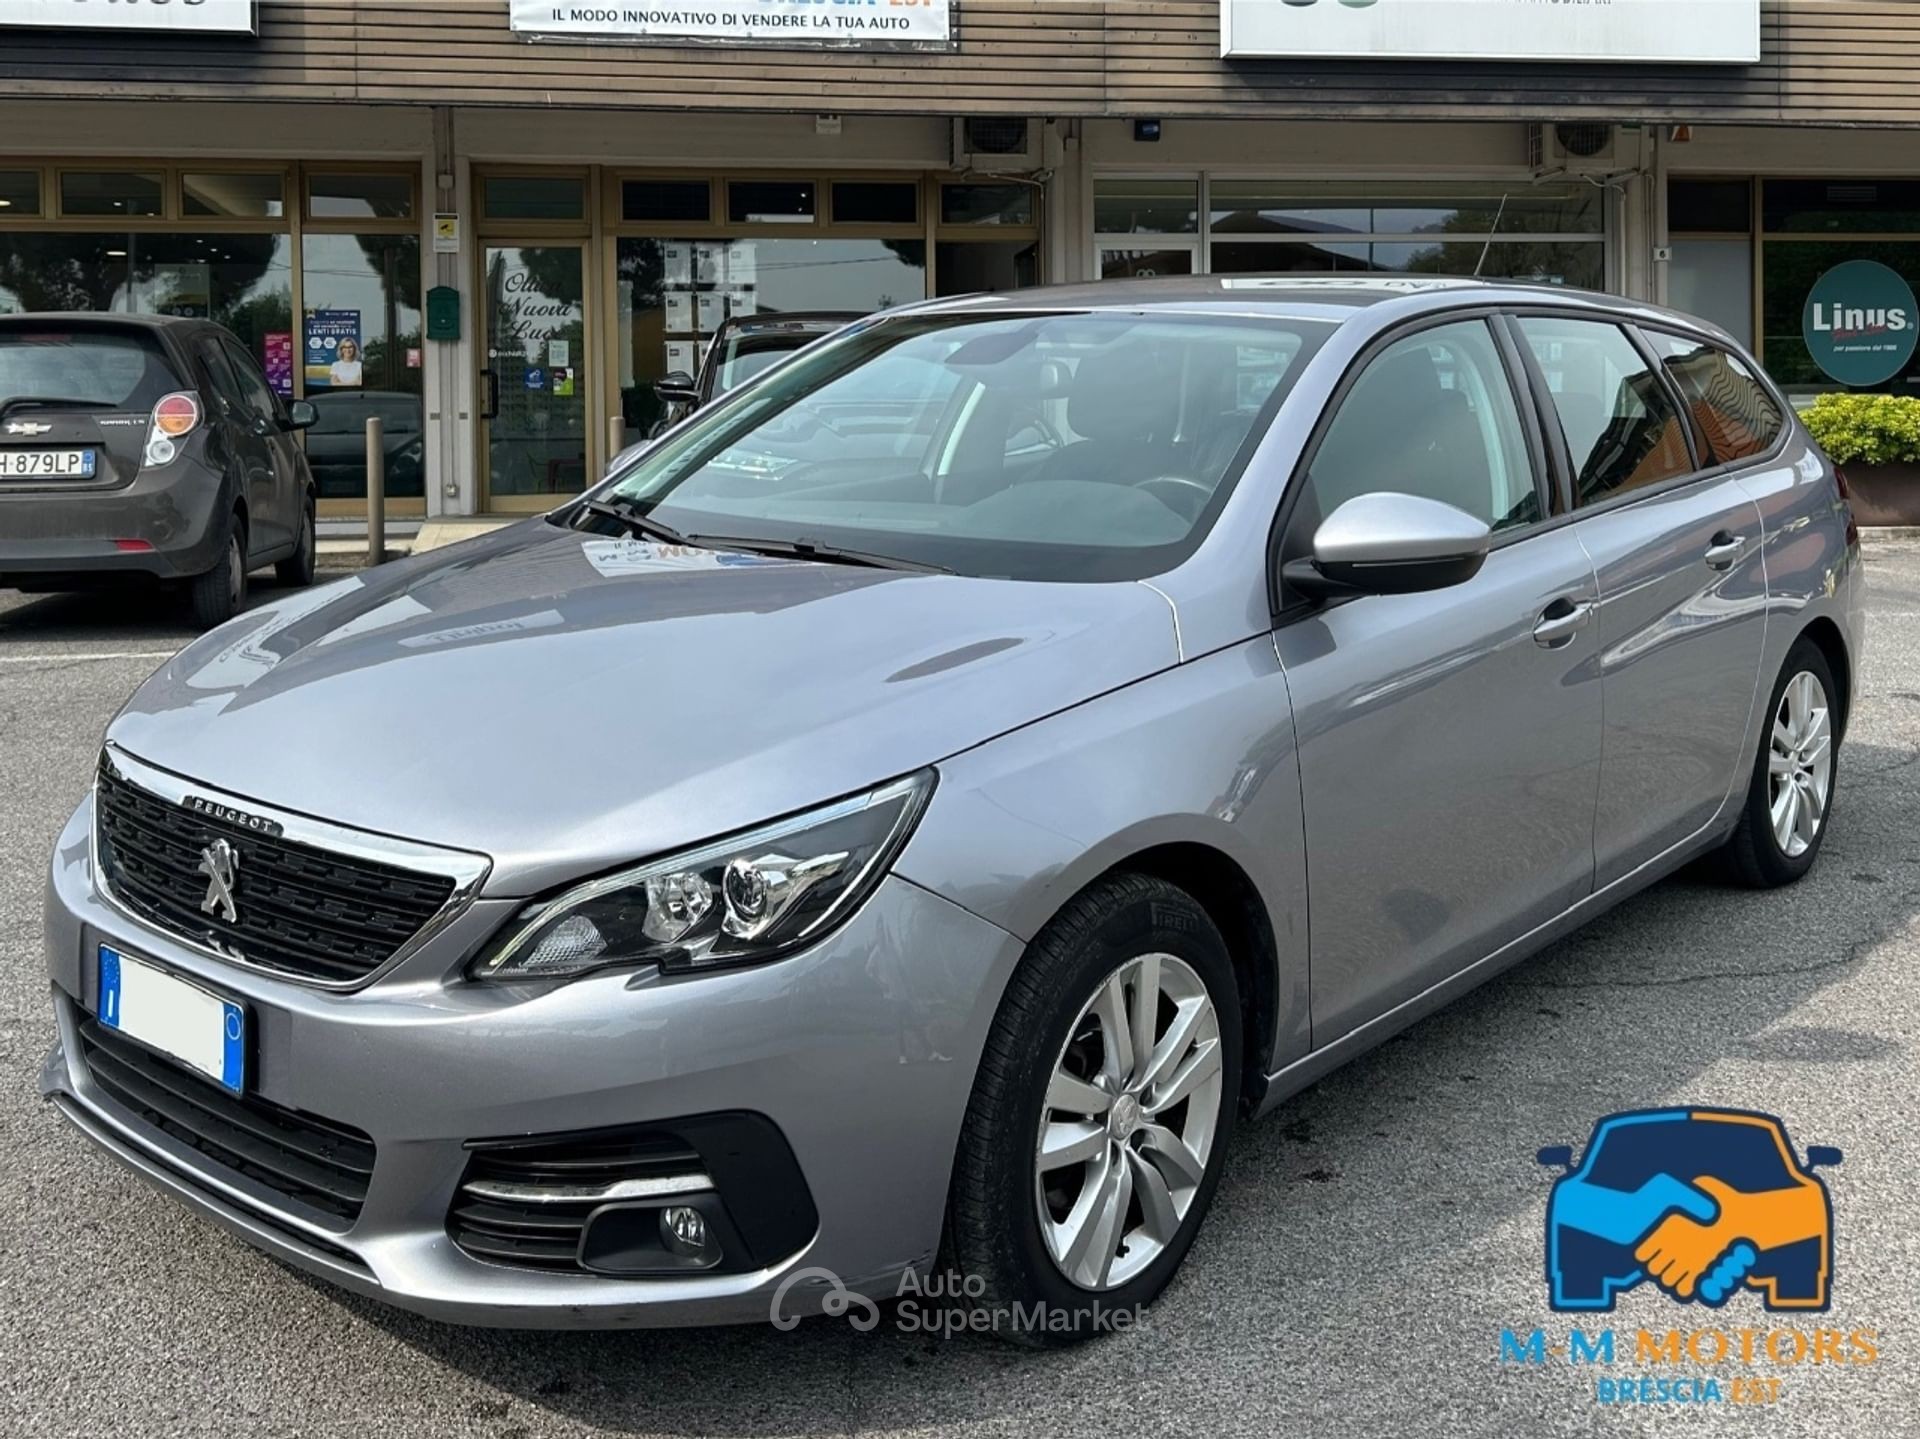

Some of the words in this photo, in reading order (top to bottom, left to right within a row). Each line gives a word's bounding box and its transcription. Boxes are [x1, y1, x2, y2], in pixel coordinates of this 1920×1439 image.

[552, 8, 566, 21] IL
[570, 9, 618, 22] MODO
[623, 10, 717, 25] INNOVATIVO
[722, 13, 737, 26] DI
[742, 14, 808, 27] VENDERE
[812, 15, 831, 27] LA
[835, 16, 865, 29] TUA
[869, 17, 910, 30] AUTO
[499, 296, 573, 317] Nuova
[1813, 303, 1906, 331] Linus
[15, 454, 80, 474] 879LP
[193, 798, 274, 833] PEUGEOT
